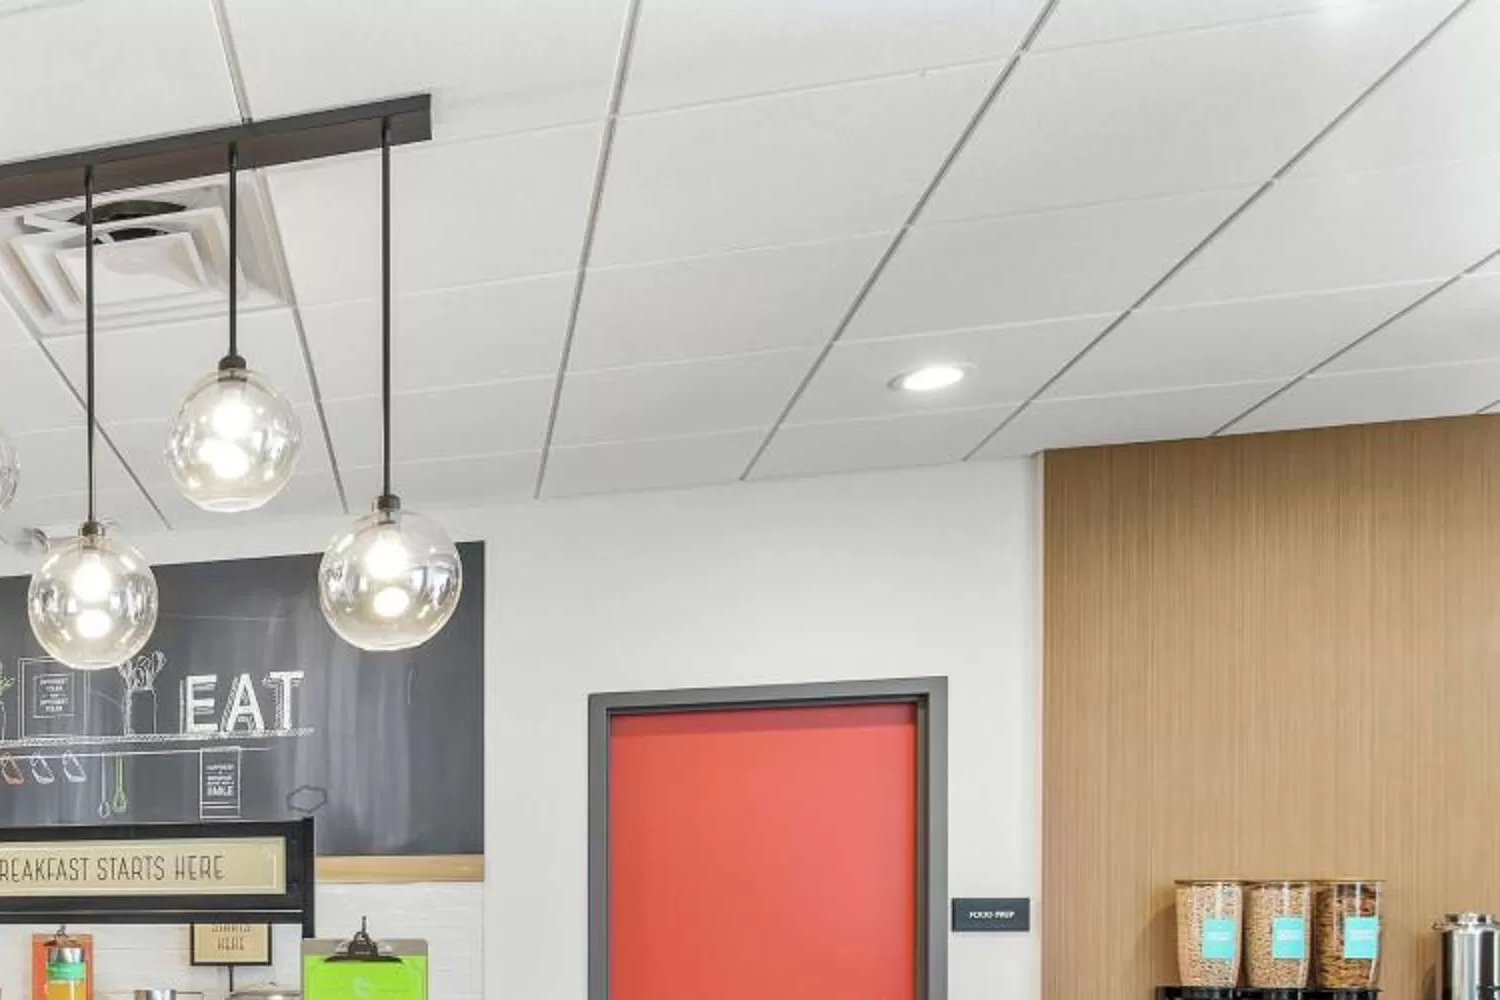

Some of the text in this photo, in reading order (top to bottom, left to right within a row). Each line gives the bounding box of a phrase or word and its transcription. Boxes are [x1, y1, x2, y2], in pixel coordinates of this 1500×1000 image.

[180, 671, 304, 736] EAT
[97, 856, 166, 881] STARTS
[174, 855, 226, 880] HERE
